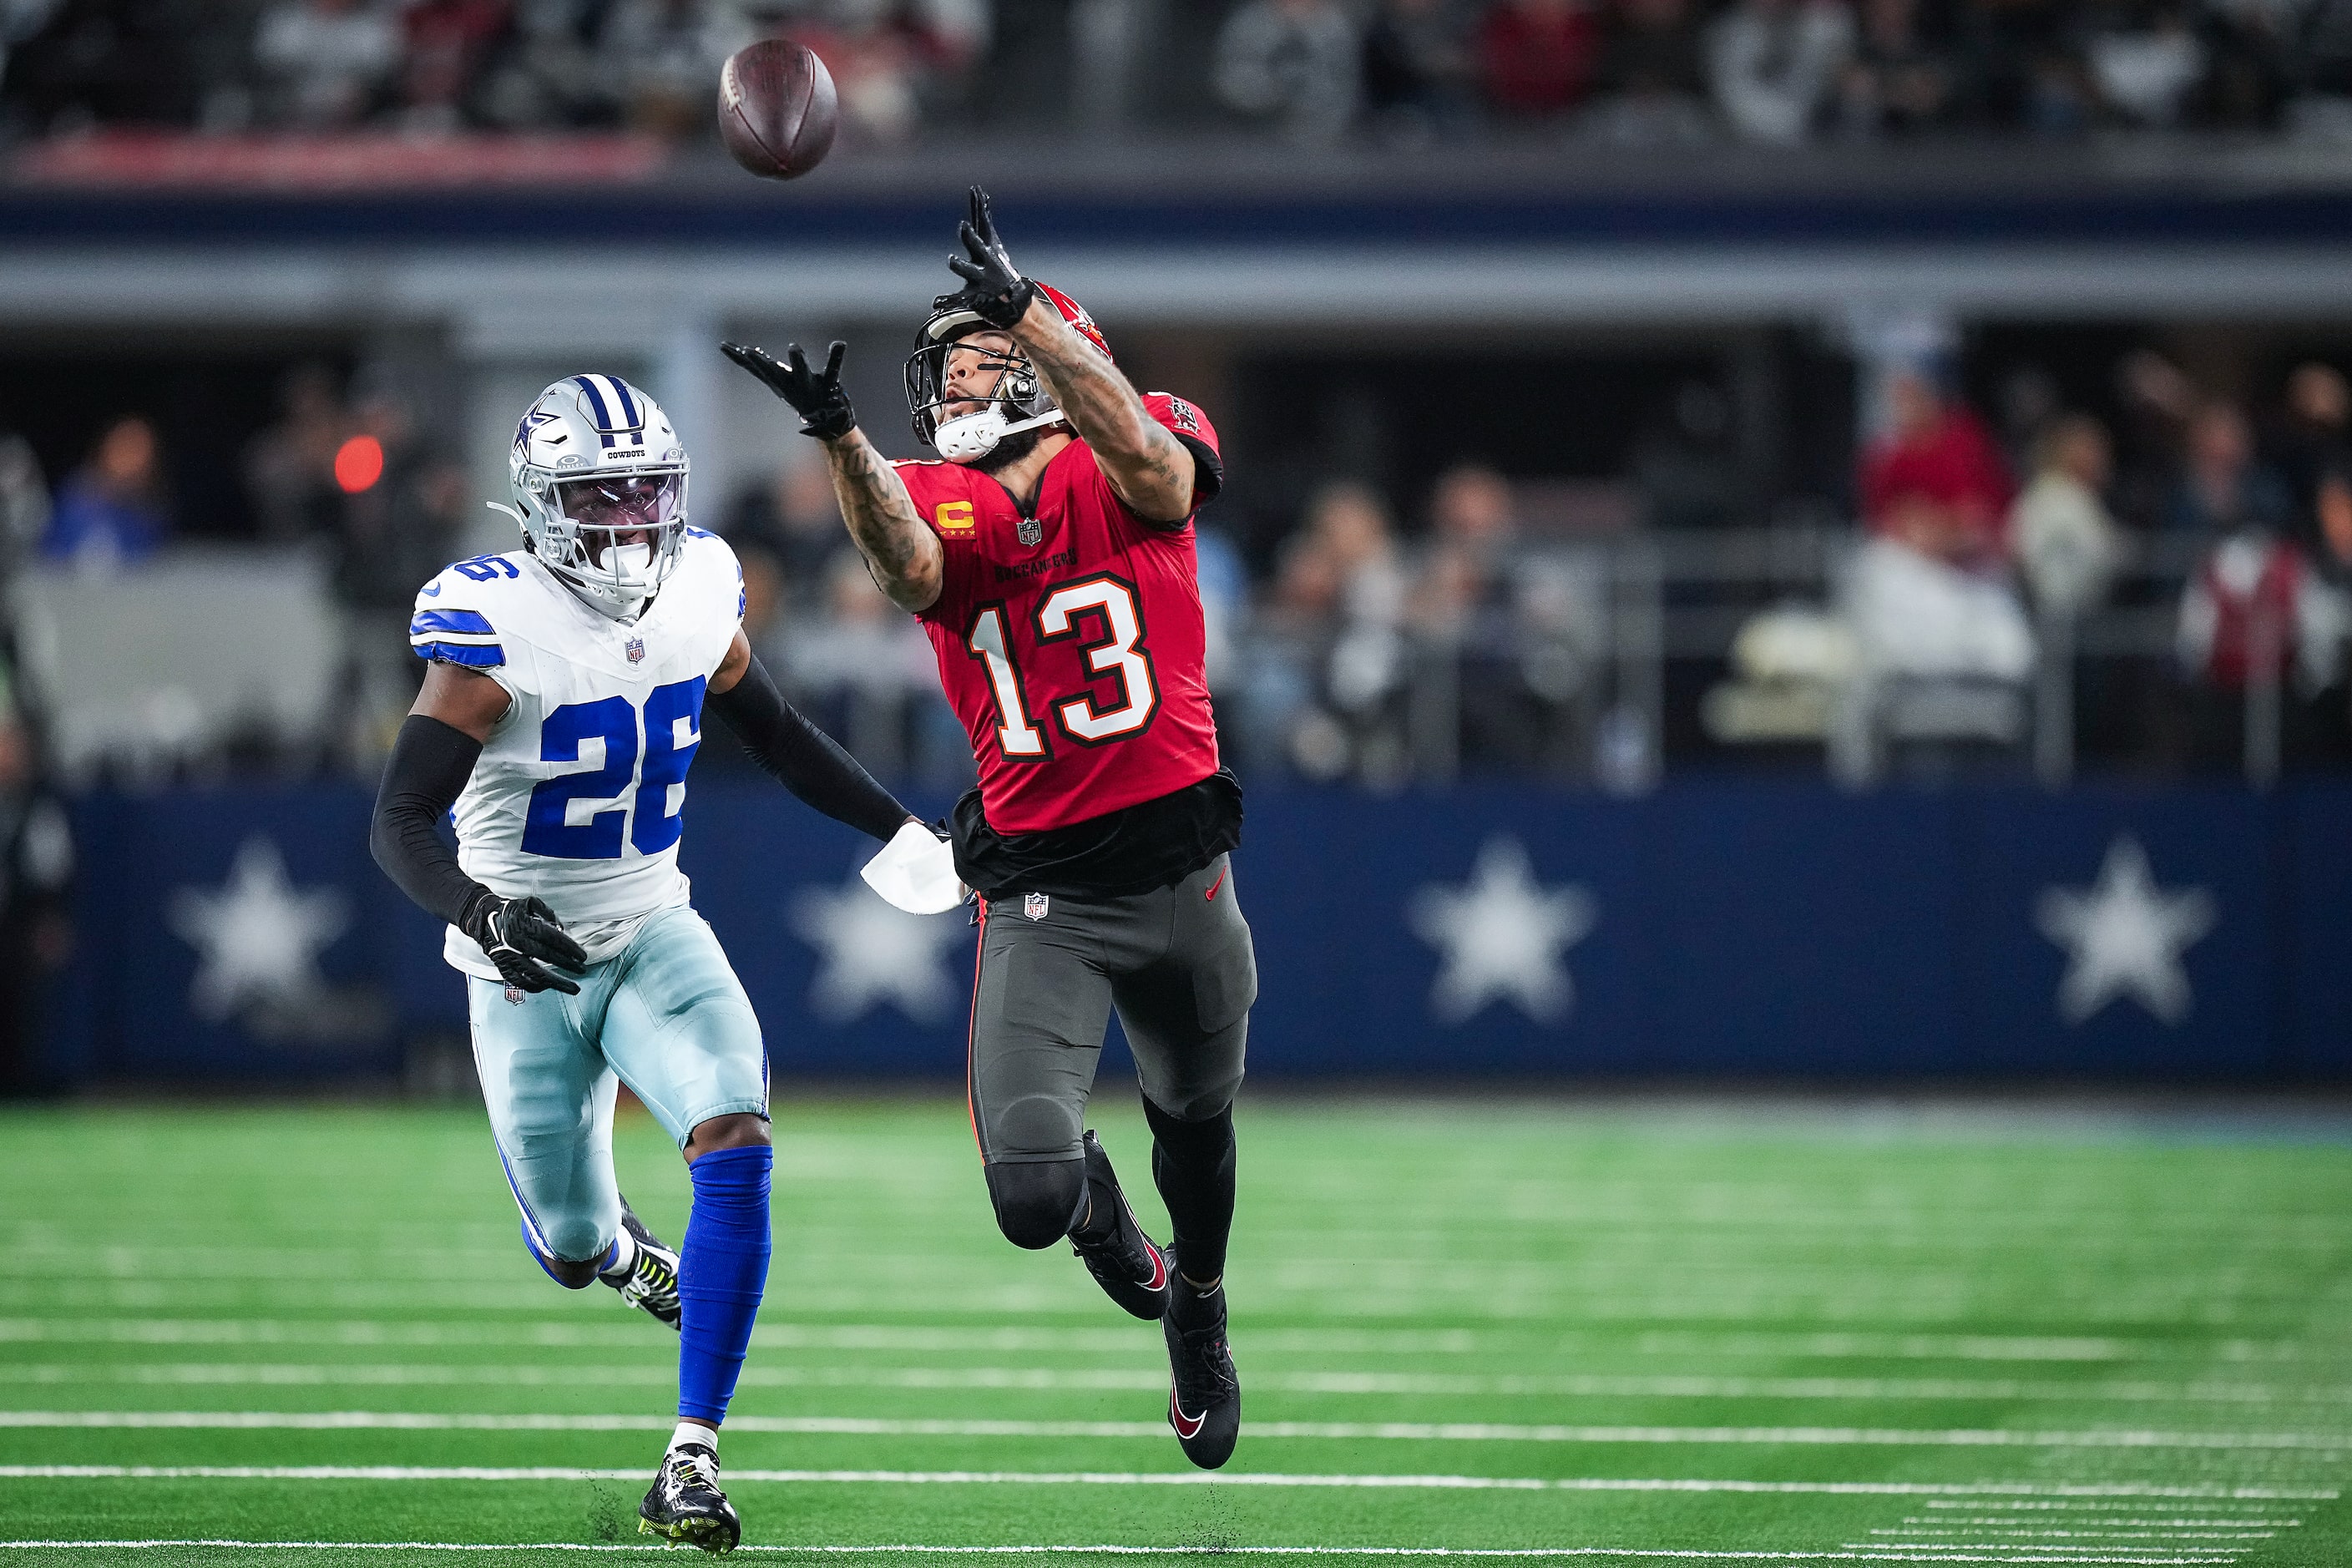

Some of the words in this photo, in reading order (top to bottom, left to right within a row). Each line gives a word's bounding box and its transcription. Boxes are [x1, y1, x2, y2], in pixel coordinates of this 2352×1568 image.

[608, 450, 645, 459] COWBOYS
[936, 501, 974, 529] C
[1022, 530, 1039, 541] NFL
[629, 649, 643, 660] NFL
[963, 569, 1163, 761] 13
[520, 674, 707, 859] 26
[1029, 904, 1044, 915] NFL
[507, 989, 521, 1000] NFL
